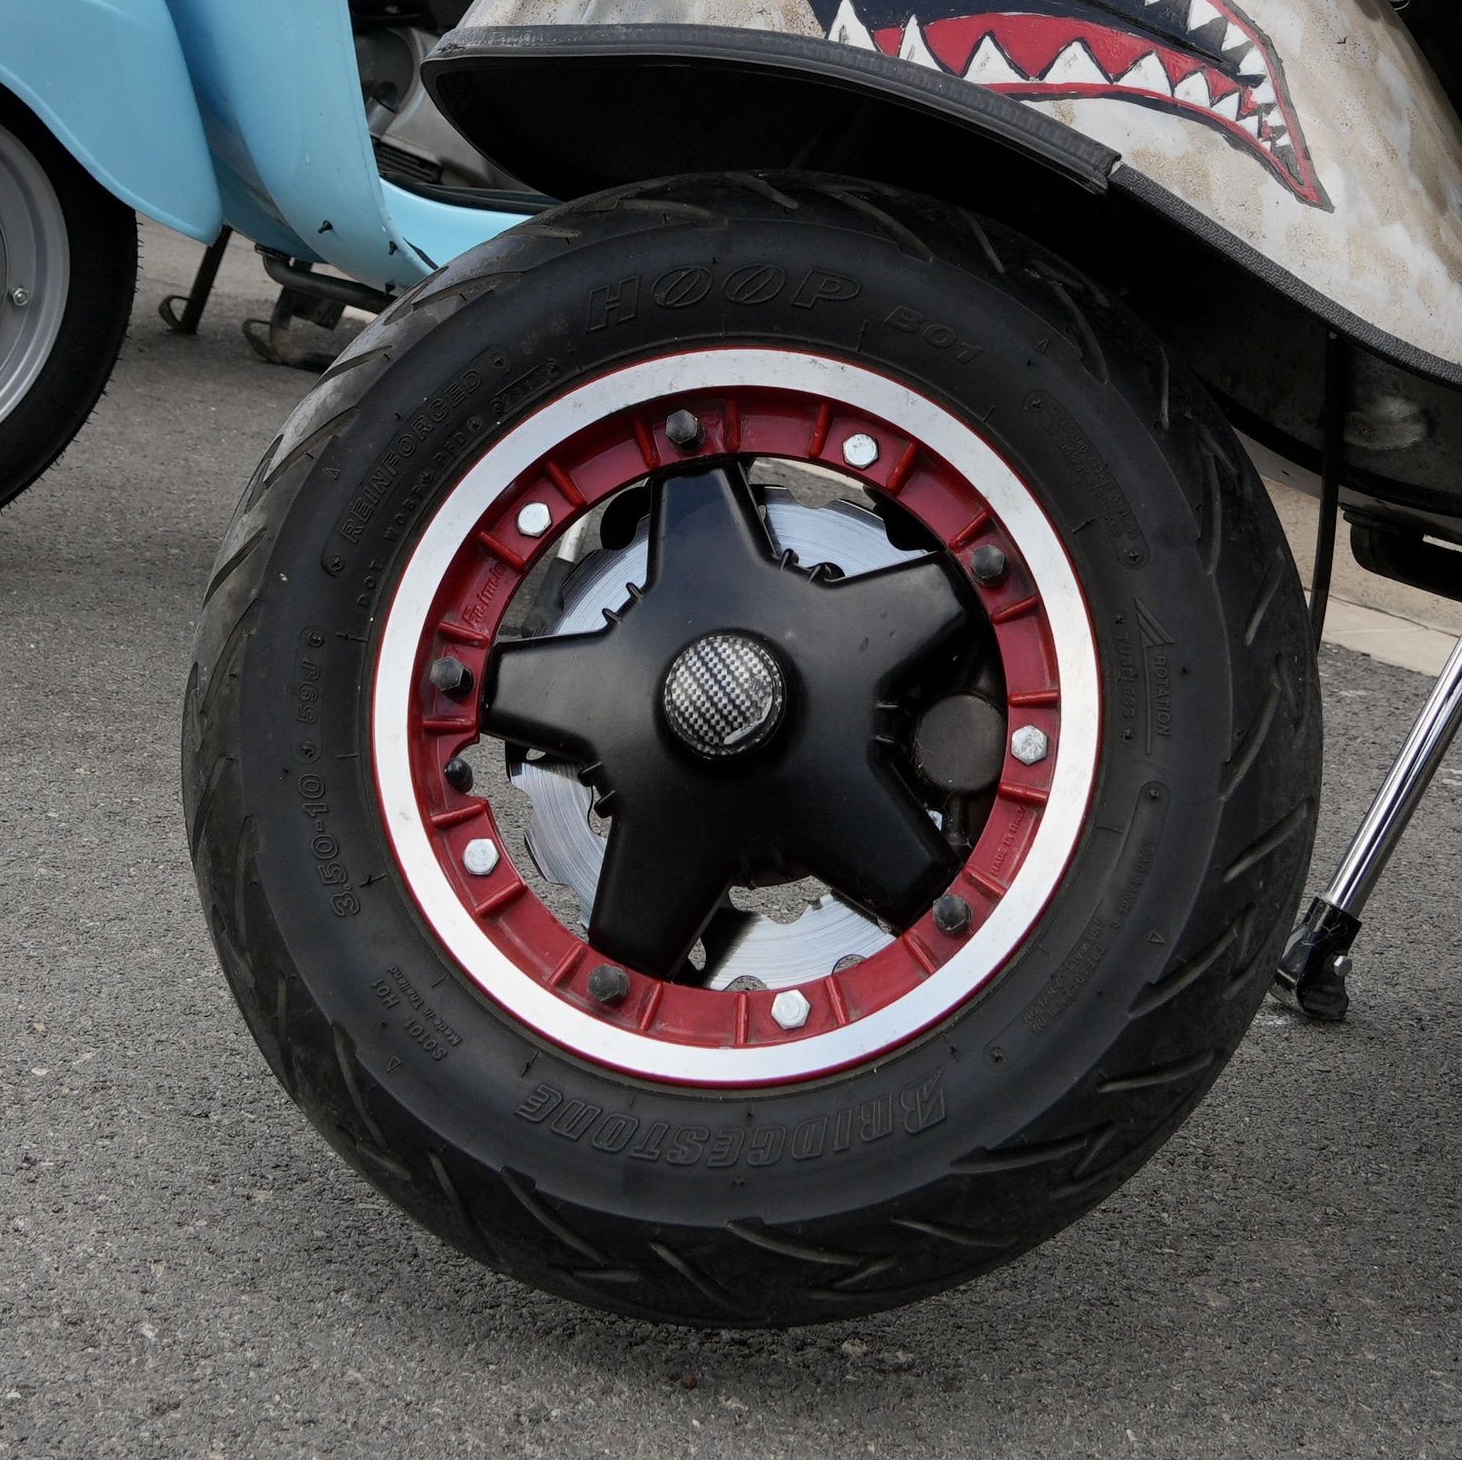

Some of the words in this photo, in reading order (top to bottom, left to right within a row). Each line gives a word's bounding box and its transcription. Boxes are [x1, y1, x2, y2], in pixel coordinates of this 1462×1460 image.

[586, 263, 865, 333] HOOP
[338, 367, 485, 547] REINFORCED
[1114, 631, 1136, 721] TUBELESS
[1154, 651, 1173, 738] ROTATION
[297, 772, 361, 919] 3.50-10
[513, 1063, 949, 1170] BRIDGESTONE
